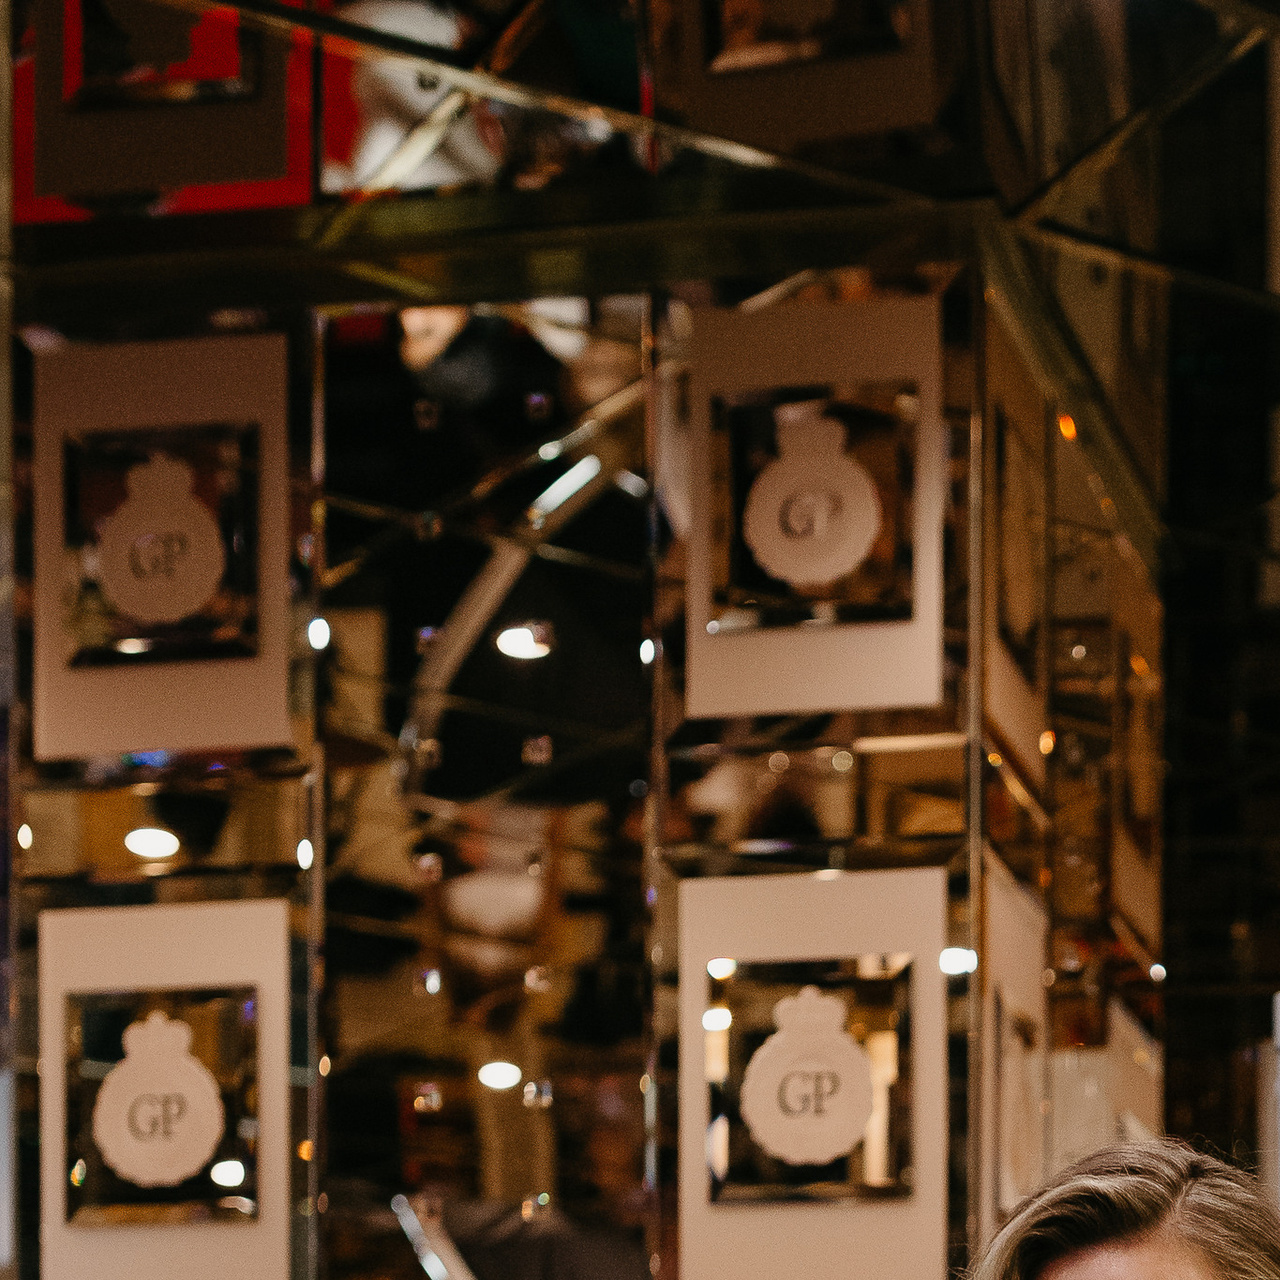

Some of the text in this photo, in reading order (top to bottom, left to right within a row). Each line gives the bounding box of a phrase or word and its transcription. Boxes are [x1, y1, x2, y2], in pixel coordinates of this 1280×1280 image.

[127, 532, 189, 580] GP
[127, 1092, 188, 1142] GP
[777, 1070, 842, 1118] GP
